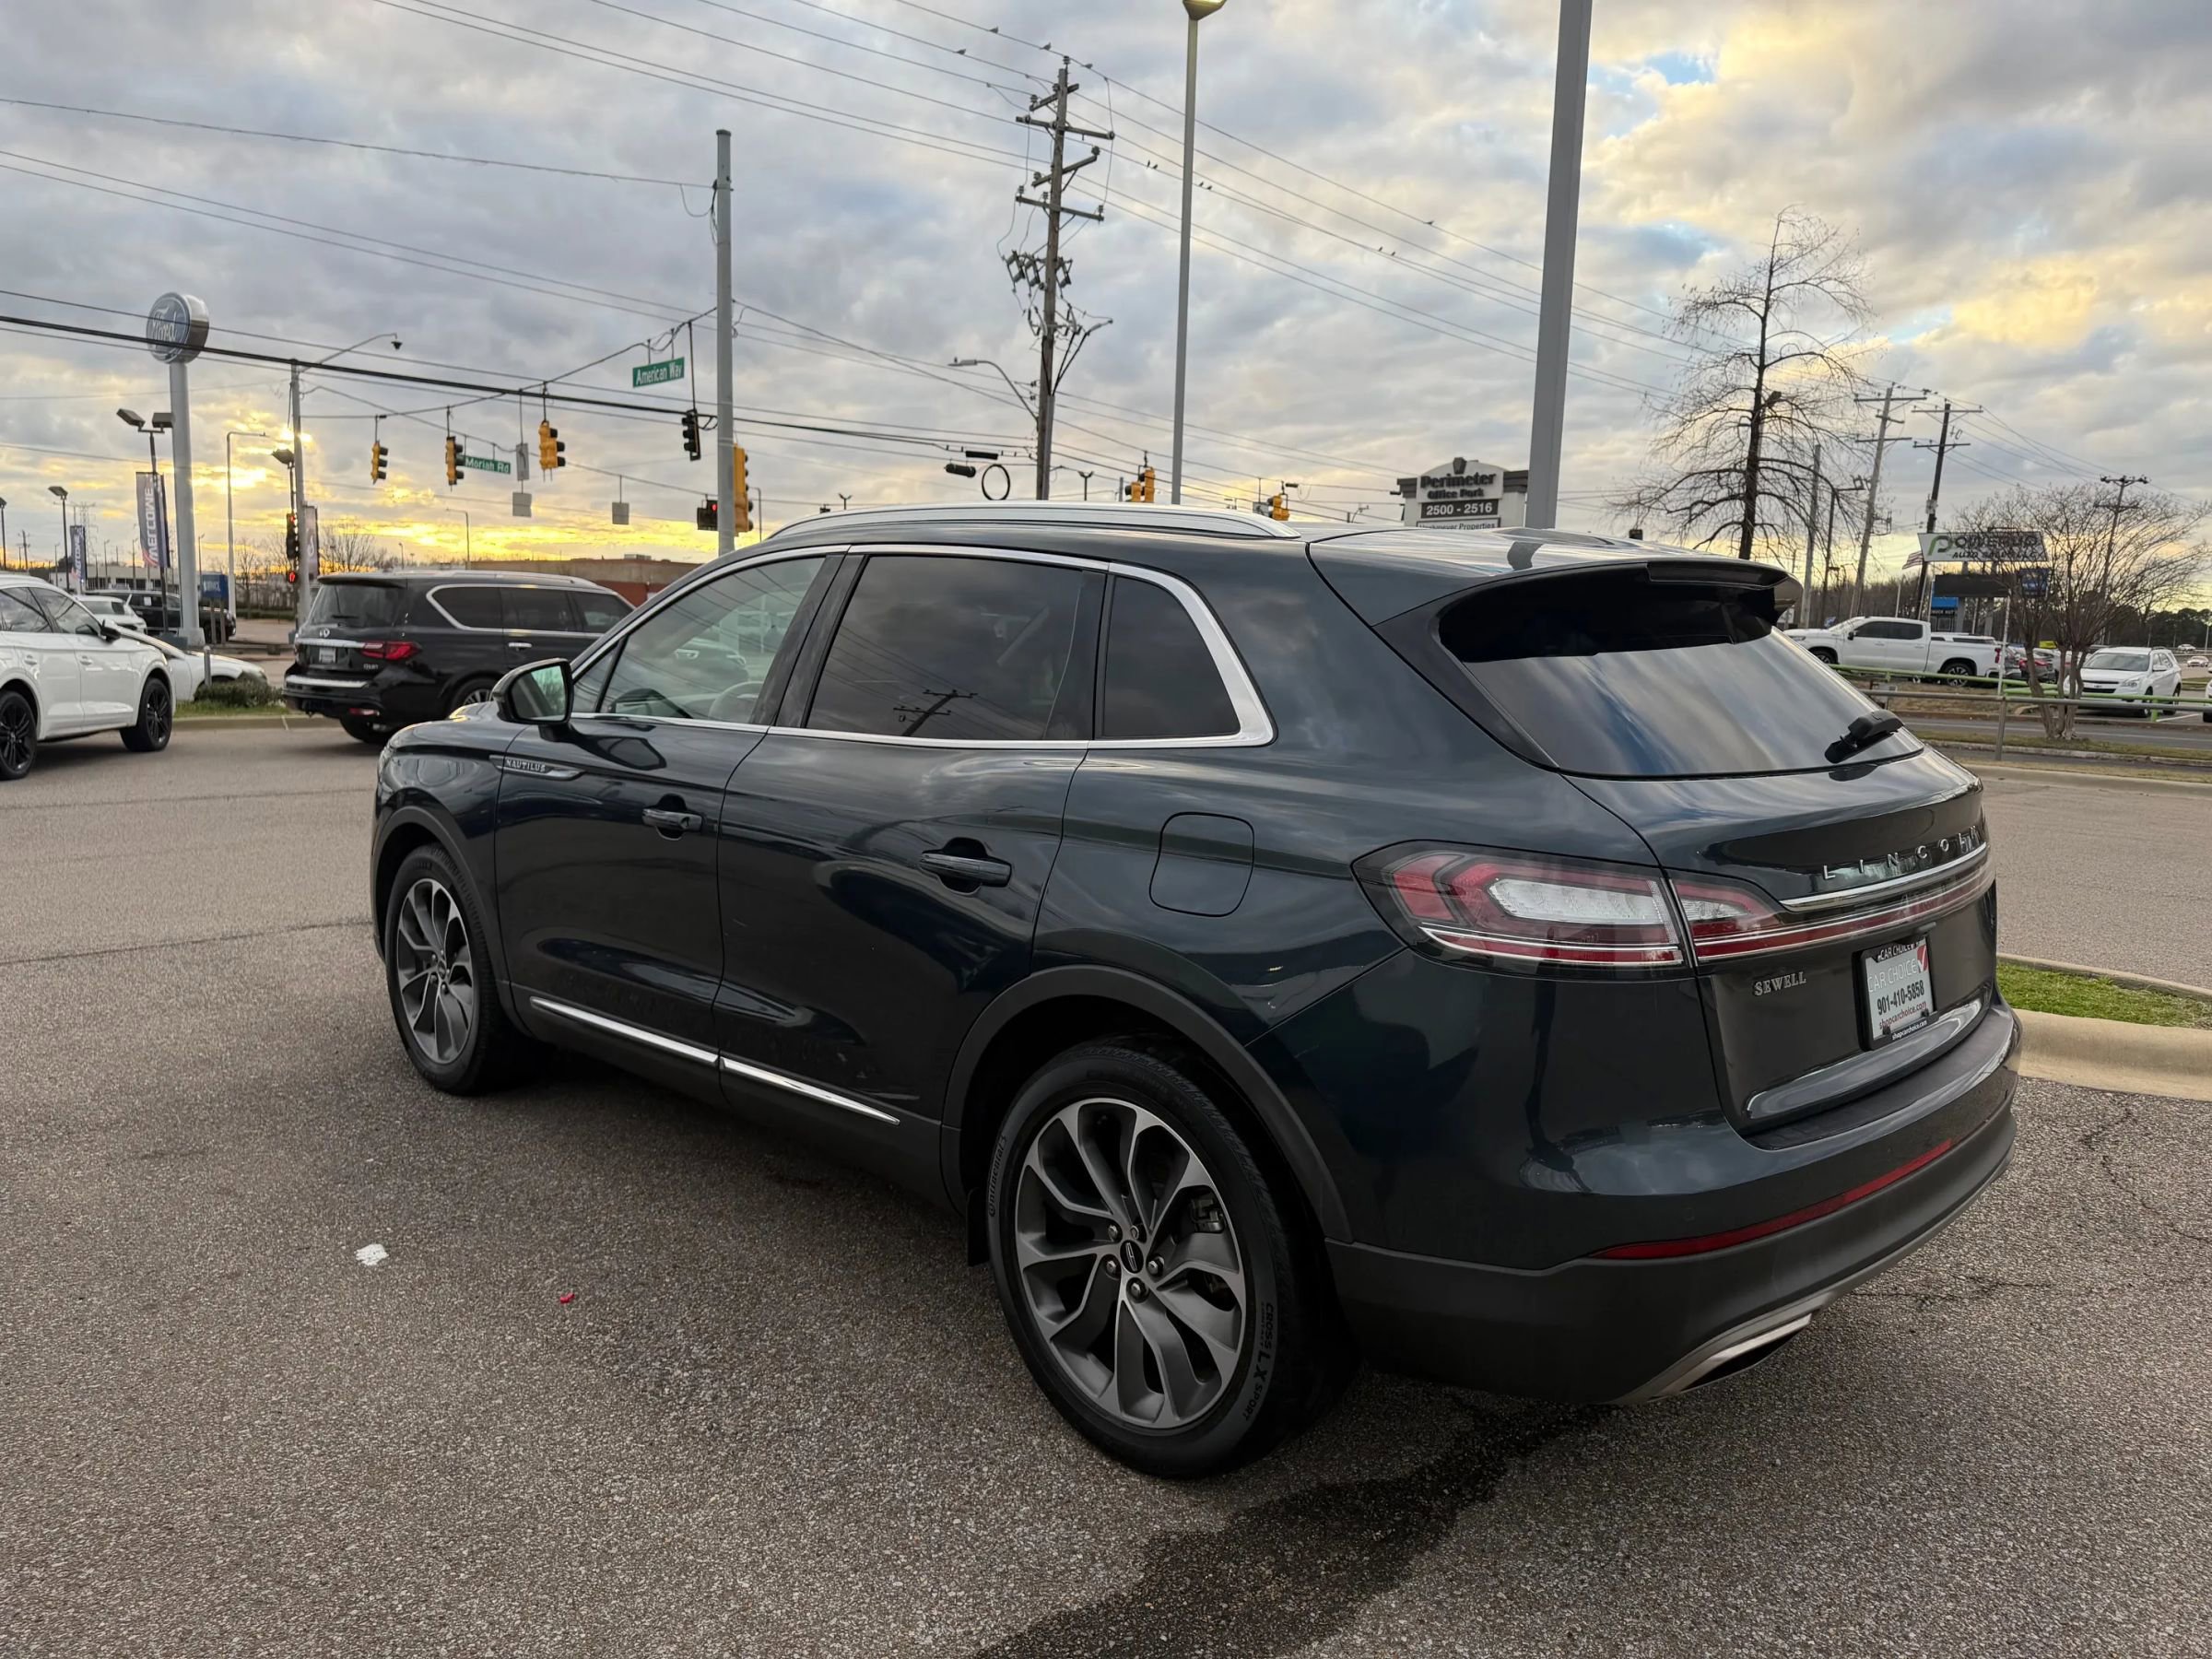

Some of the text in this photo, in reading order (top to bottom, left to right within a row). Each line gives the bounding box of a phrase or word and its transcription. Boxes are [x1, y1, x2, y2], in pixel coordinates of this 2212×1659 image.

[636, 361, 683, 385] American Way
[465, 457, 510, 473] Moriah Rd
[1420, 472, 1497, 488] Perimeter
[1428, 488, 1484, 500] Office Park
[1426, 504, 1453, 515] 2500
[1464, 502, 1493, 513] 2516
[506, 759, 546, 772] NAUTILUS
[1754, 971, 1806, 996] SEWELL
[1867, 958, 1917, 993] CAR CHOICE
[1877, 980, 1924, 1015] 901-410-5858
[1880, 1001, 1926, 1030] shopcarchoice.com
[1242, 1383, 1263, 1420] SPORT
